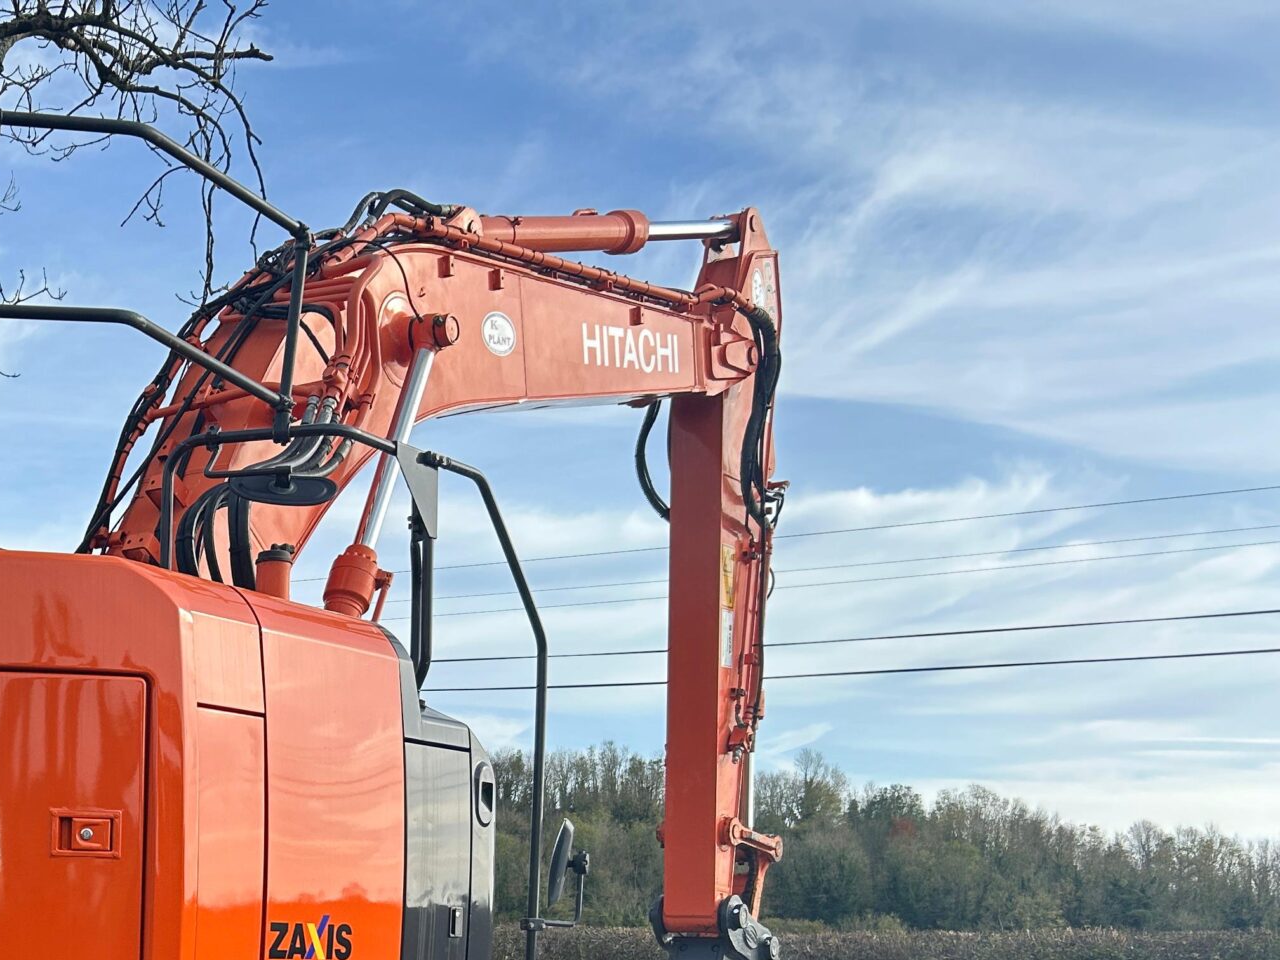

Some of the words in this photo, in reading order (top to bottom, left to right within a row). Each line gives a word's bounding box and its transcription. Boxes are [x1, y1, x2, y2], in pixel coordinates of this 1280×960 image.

[488, 334, 512, 346] PLANT
[582, 322, 679, 374] HITACHI
[268, 915, 353, 960] ZAXIS
